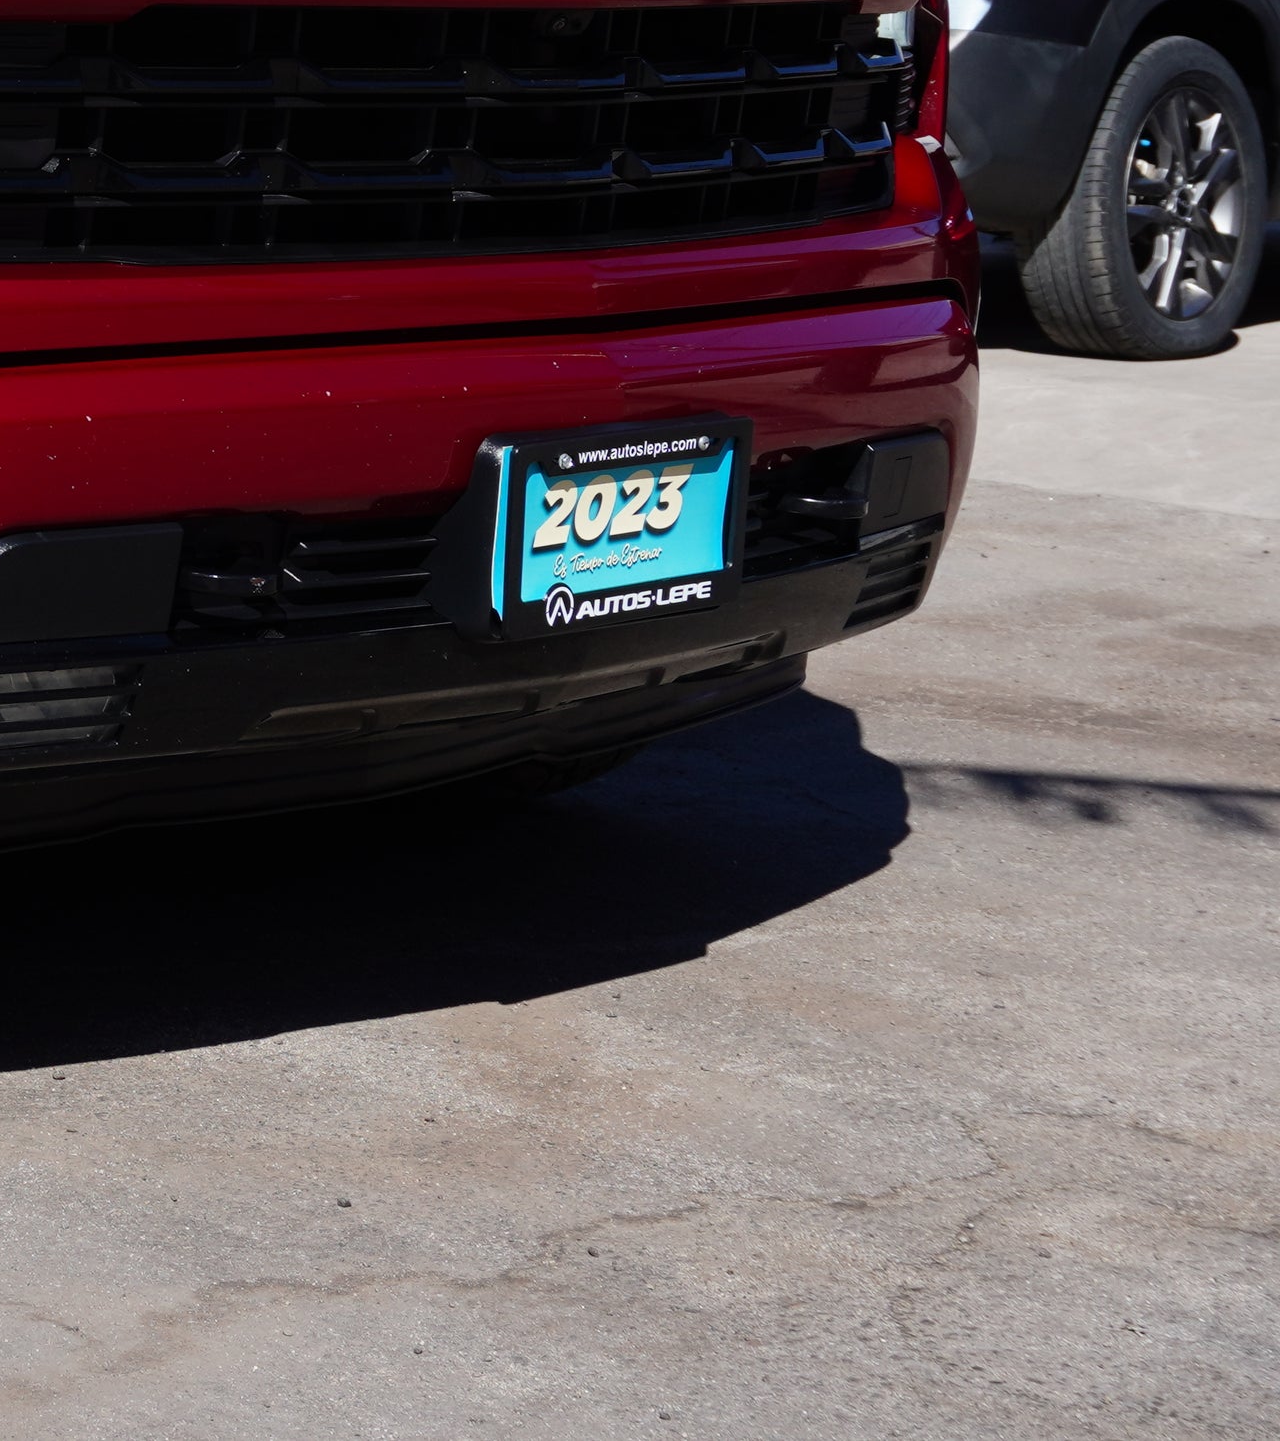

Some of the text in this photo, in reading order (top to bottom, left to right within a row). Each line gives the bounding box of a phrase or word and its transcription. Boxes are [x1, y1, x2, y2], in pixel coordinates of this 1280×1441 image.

[578, 438, 697, 464] www.autoslepe.com
[532, 463, 694, 549] 2023
[553, 543, 662, 578] Es Tiempo de Estrenar
